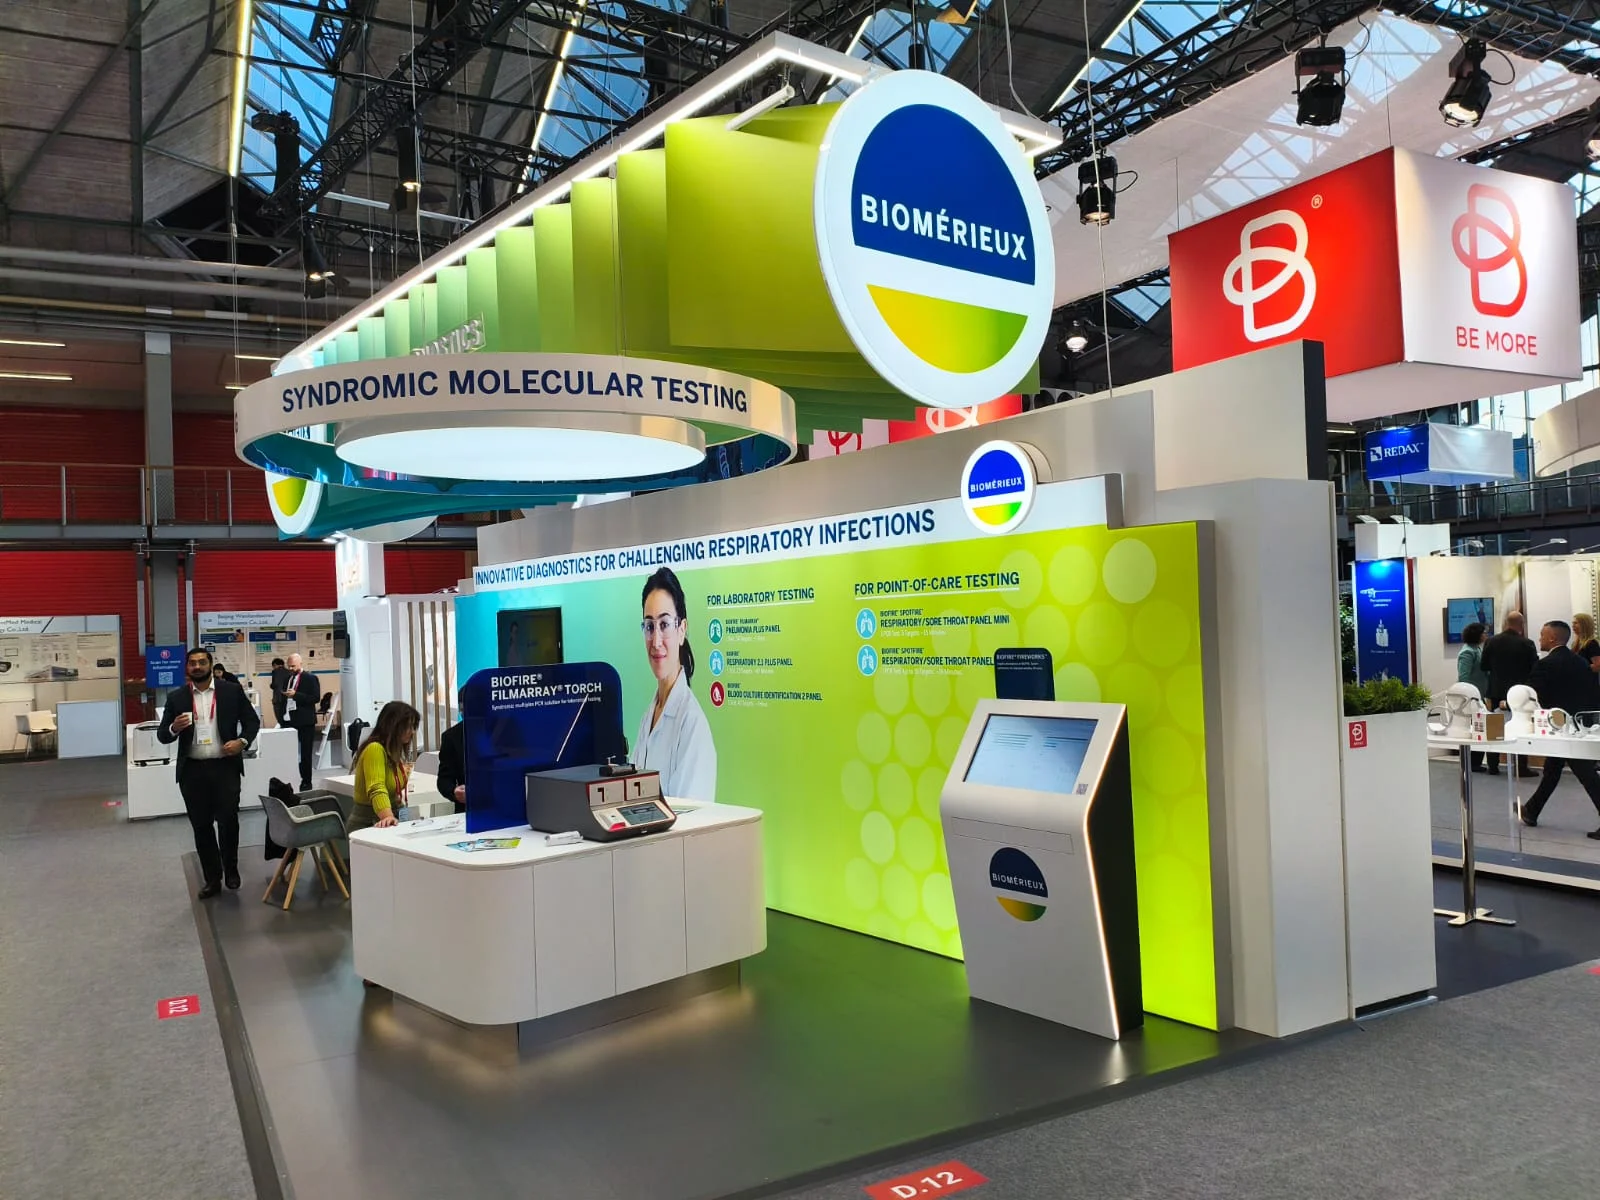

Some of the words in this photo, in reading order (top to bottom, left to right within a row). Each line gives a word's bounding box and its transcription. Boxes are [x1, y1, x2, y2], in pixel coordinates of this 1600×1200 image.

[861, 193, 1027, 261] BIOMÉRIEUX
[1456, 326, 1480, 350] BE
[1486, 328, 1538, 356] MORE
[282, 371, 438, 413] SYNDROMIC
[449, 369, 643, 398] MOLECULAR
[650, 376, 748, 412] TESTING
[970, 477, 1022, 492] BIOMÉRIEUX
[475, 566, 524, 585] INNOVATIVE
[526, 556, 591, 579] DIAGNOSTICS
[594, 553, 615, 571] FOR
[618, 541, 704, 569] CHALLENGING
[708, 526, 814, 558] RESPIRATORY
[819, 508, 935, 545] INFECTIONS
[854, 582, 874, 596] FOR
[877, 575, 962, 594] POINT-OF-CARE
[965, 571, 1020, 588] TESTING
[707, 595, 721, 605] FOR
[723, 591, 775, 605] LABORATORY
[777, 587, 815, 600] TESTING
[943, 616, 969, 626] THROAT
[970, 615, 992, 625] PANEL
[993, 615, 1010, 624] MINI
[944, 656, 971, 665] THROAT
[971, 657, 994, 666] PANEL
[565, 682, 602, 694] TORCH
[992, 873, 1044, 891] BIOMÉRIEUX
[890, 1171, 963, 1199] D.12
